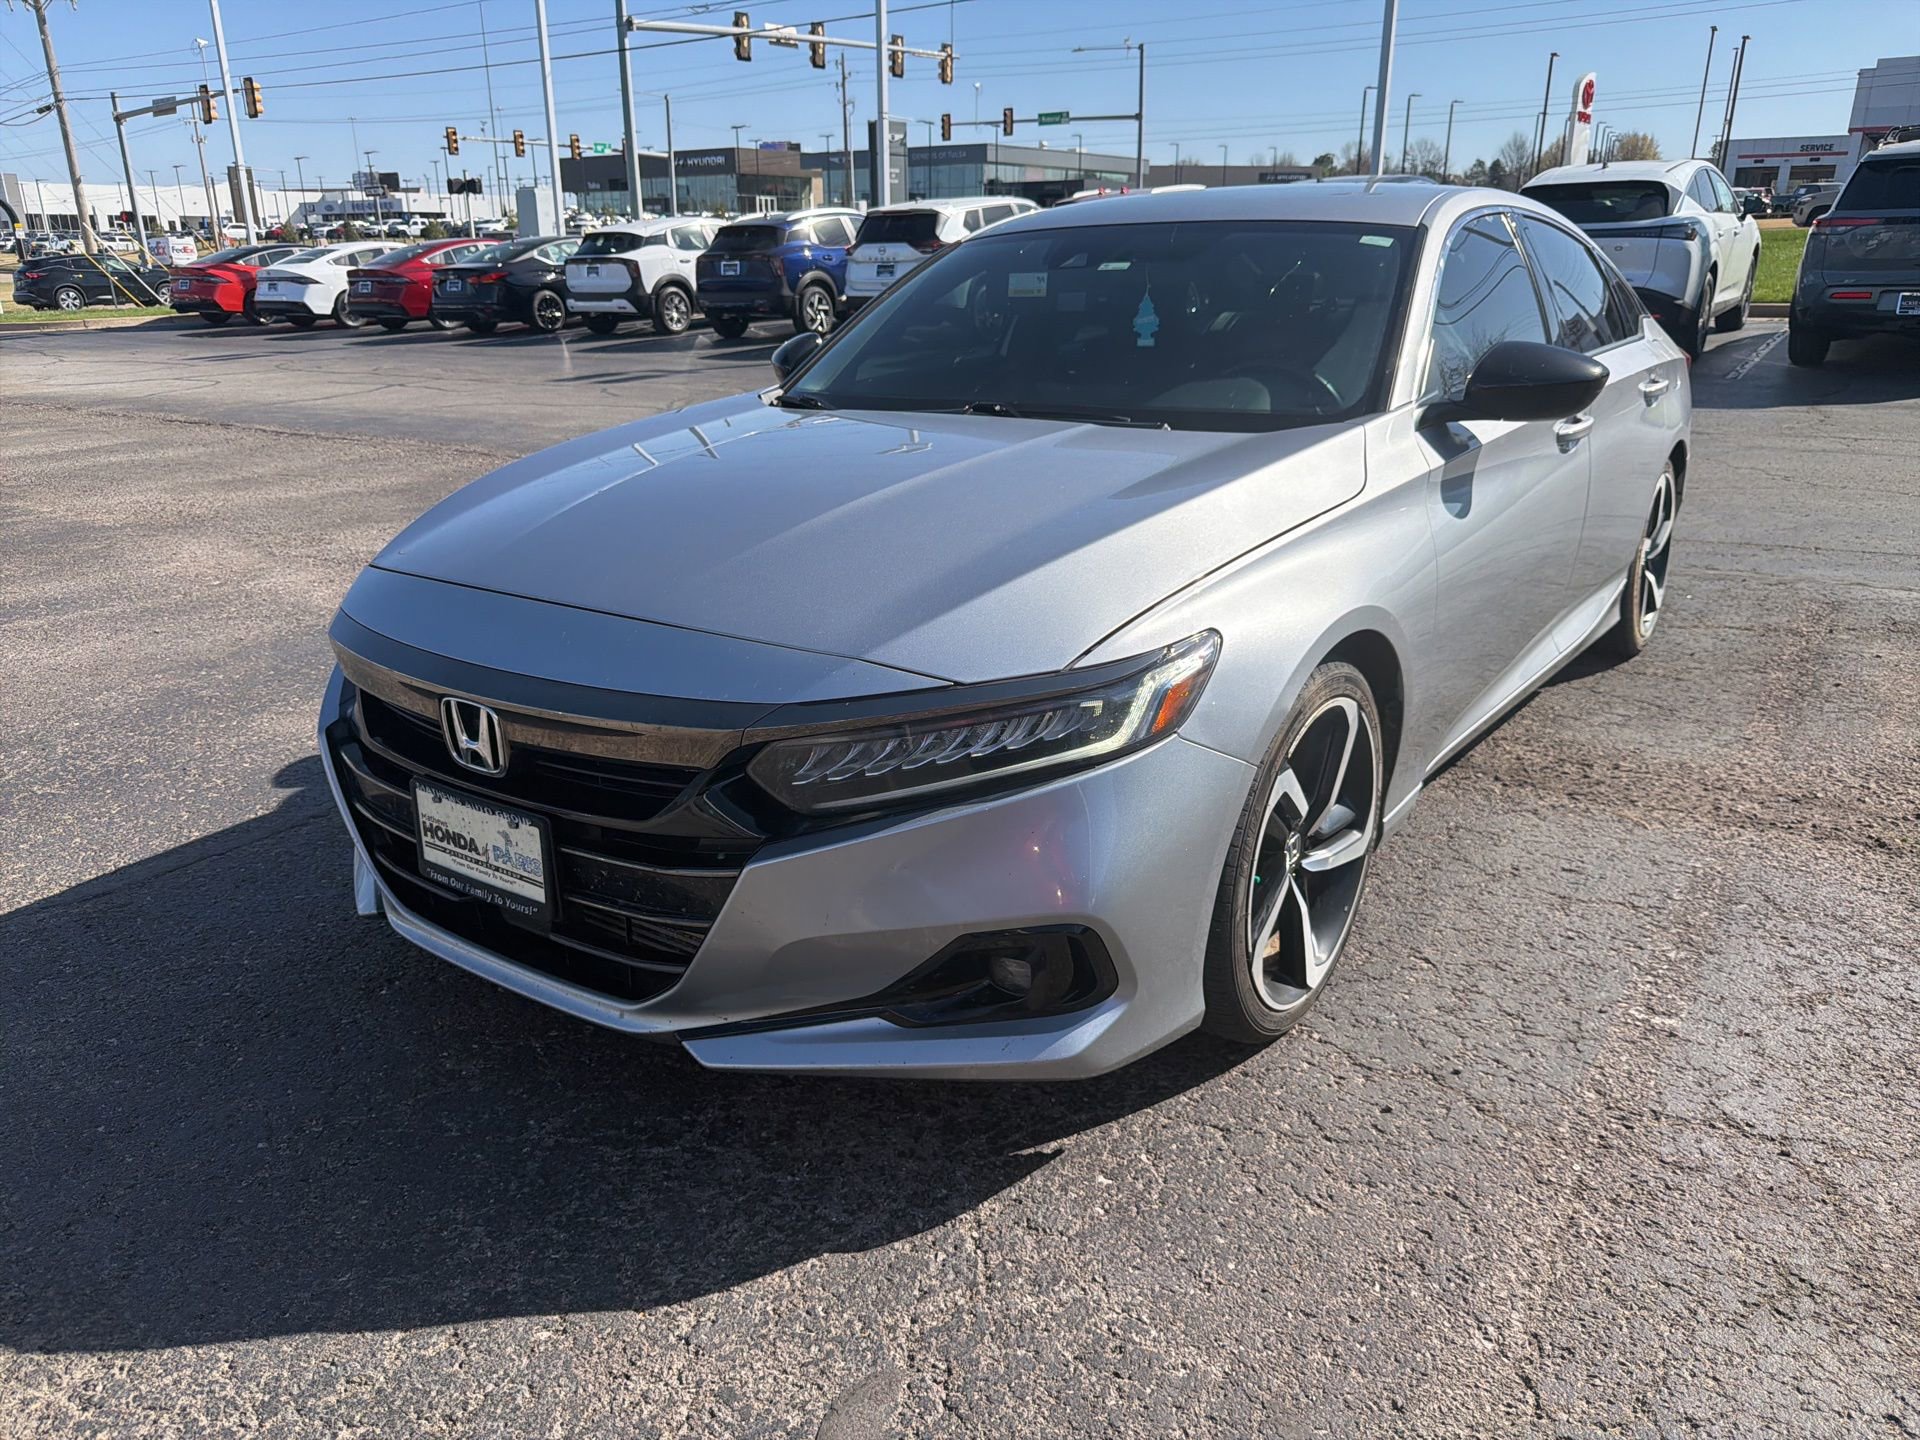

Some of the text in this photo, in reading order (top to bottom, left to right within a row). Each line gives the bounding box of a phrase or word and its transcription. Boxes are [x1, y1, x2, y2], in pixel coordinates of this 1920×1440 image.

[1800, 144, 1834, 152] SERVICE
[687, 156, 725, 167] HYUNDAI
[171, 245, 193, 254] FedEx
[421, 812, 449, 828] Mathews
[422, 820, 481, 857] HONDA
[492, 843, 543, 877] PARIS
[426, 868, 449, 885] "From
[450, 878, 465, 891] Our
[466, 884, 492, 903] Family
[493, 894, 503, 904] To
